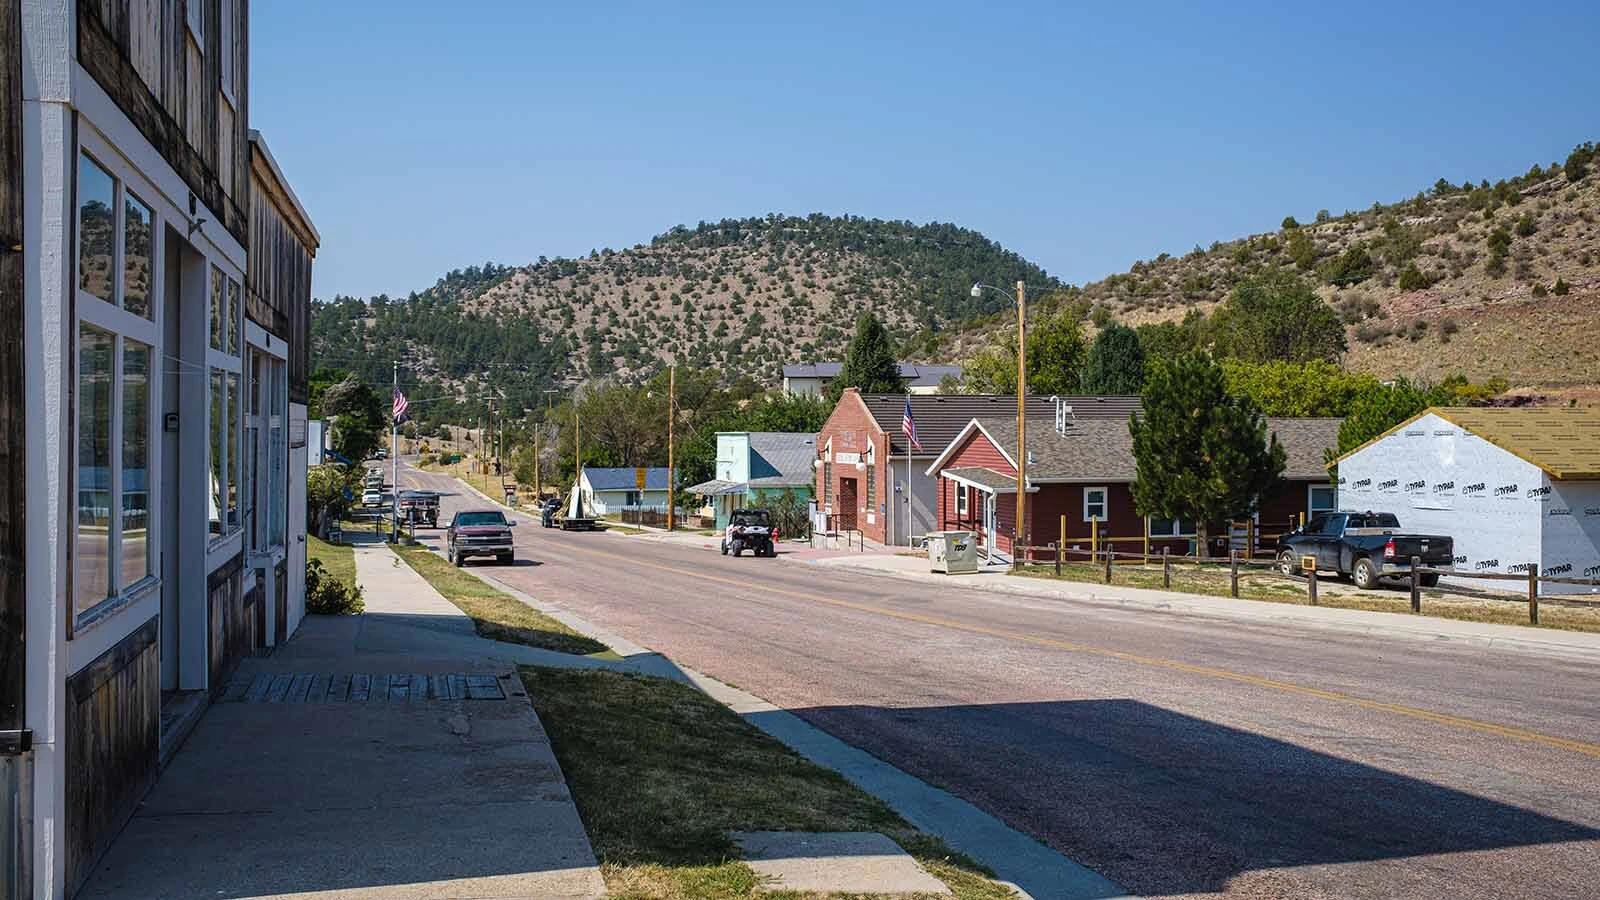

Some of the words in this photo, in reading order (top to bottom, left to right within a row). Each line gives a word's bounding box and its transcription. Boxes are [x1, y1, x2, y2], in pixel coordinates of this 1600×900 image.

[1409, 480, 1426, 490] TYPAR
[1437, 481, 1455, 492] TYPAR
[1467, 482, 1486, 494] TYPAR
[1499, 483, 1518, 495] TYPAR
[1480, 559, 1499, 569] TYPAR
[1549, 563, 1573, 576] TYPAR
